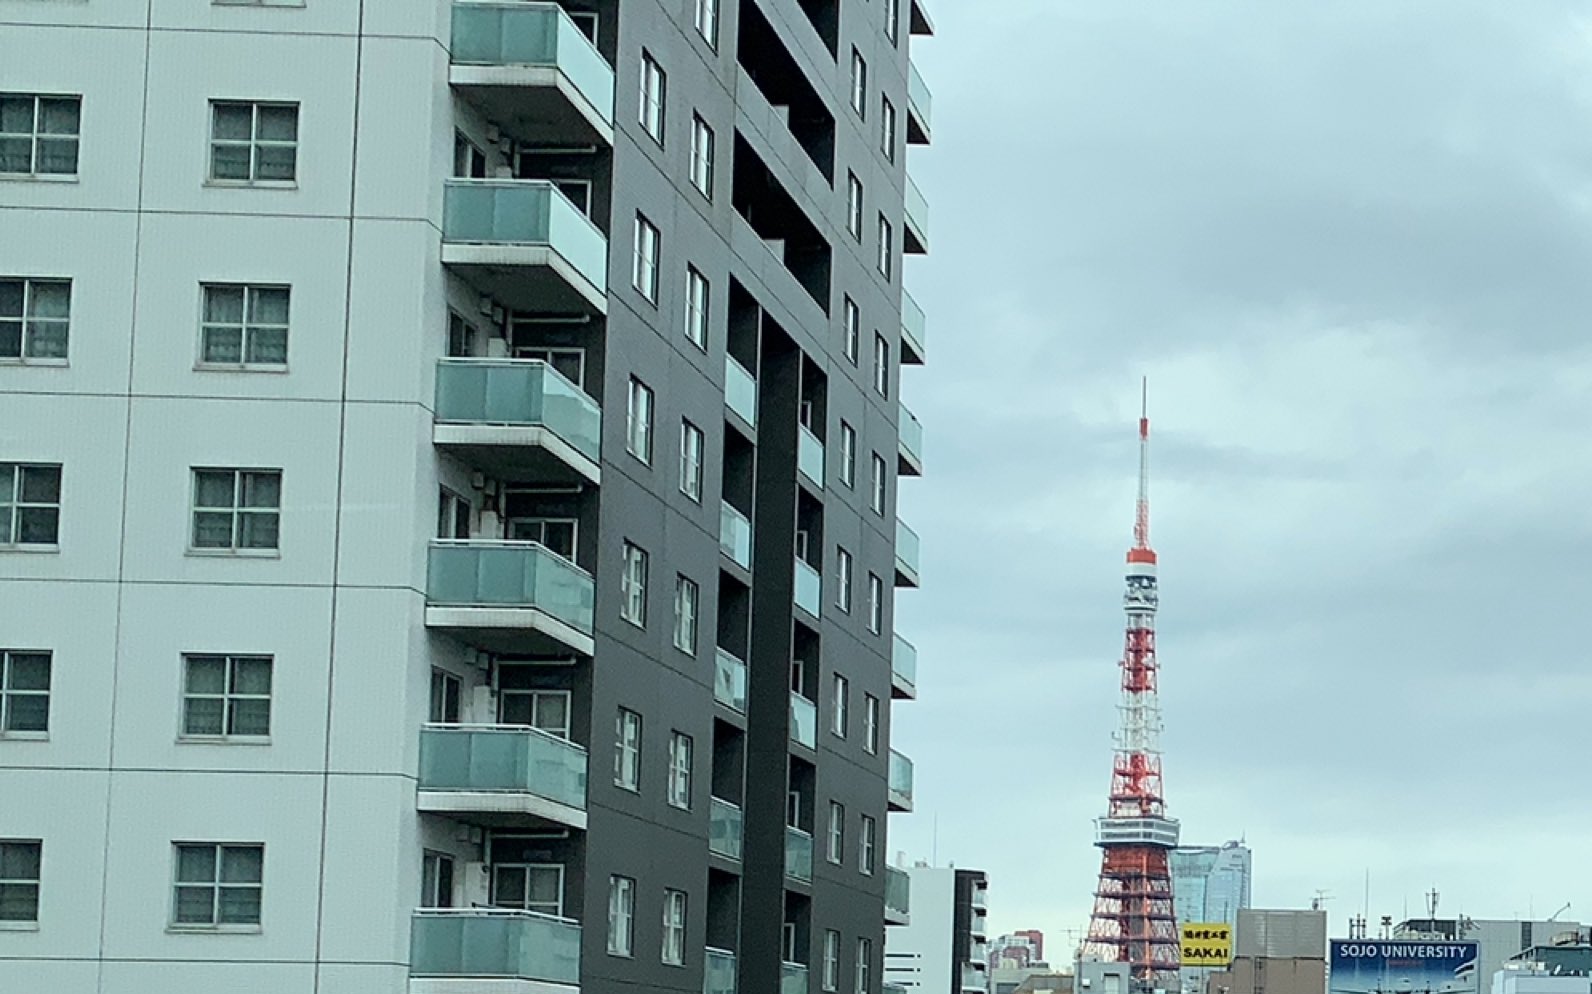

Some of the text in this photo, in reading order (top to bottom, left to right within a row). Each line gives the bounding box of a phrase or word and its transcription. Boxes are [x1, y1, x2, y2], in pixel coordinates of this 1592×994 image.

[1184, 948, 1228, 958] SAKAI
[1340, 944, 1467, 958] SOJO UNIVERSITY
